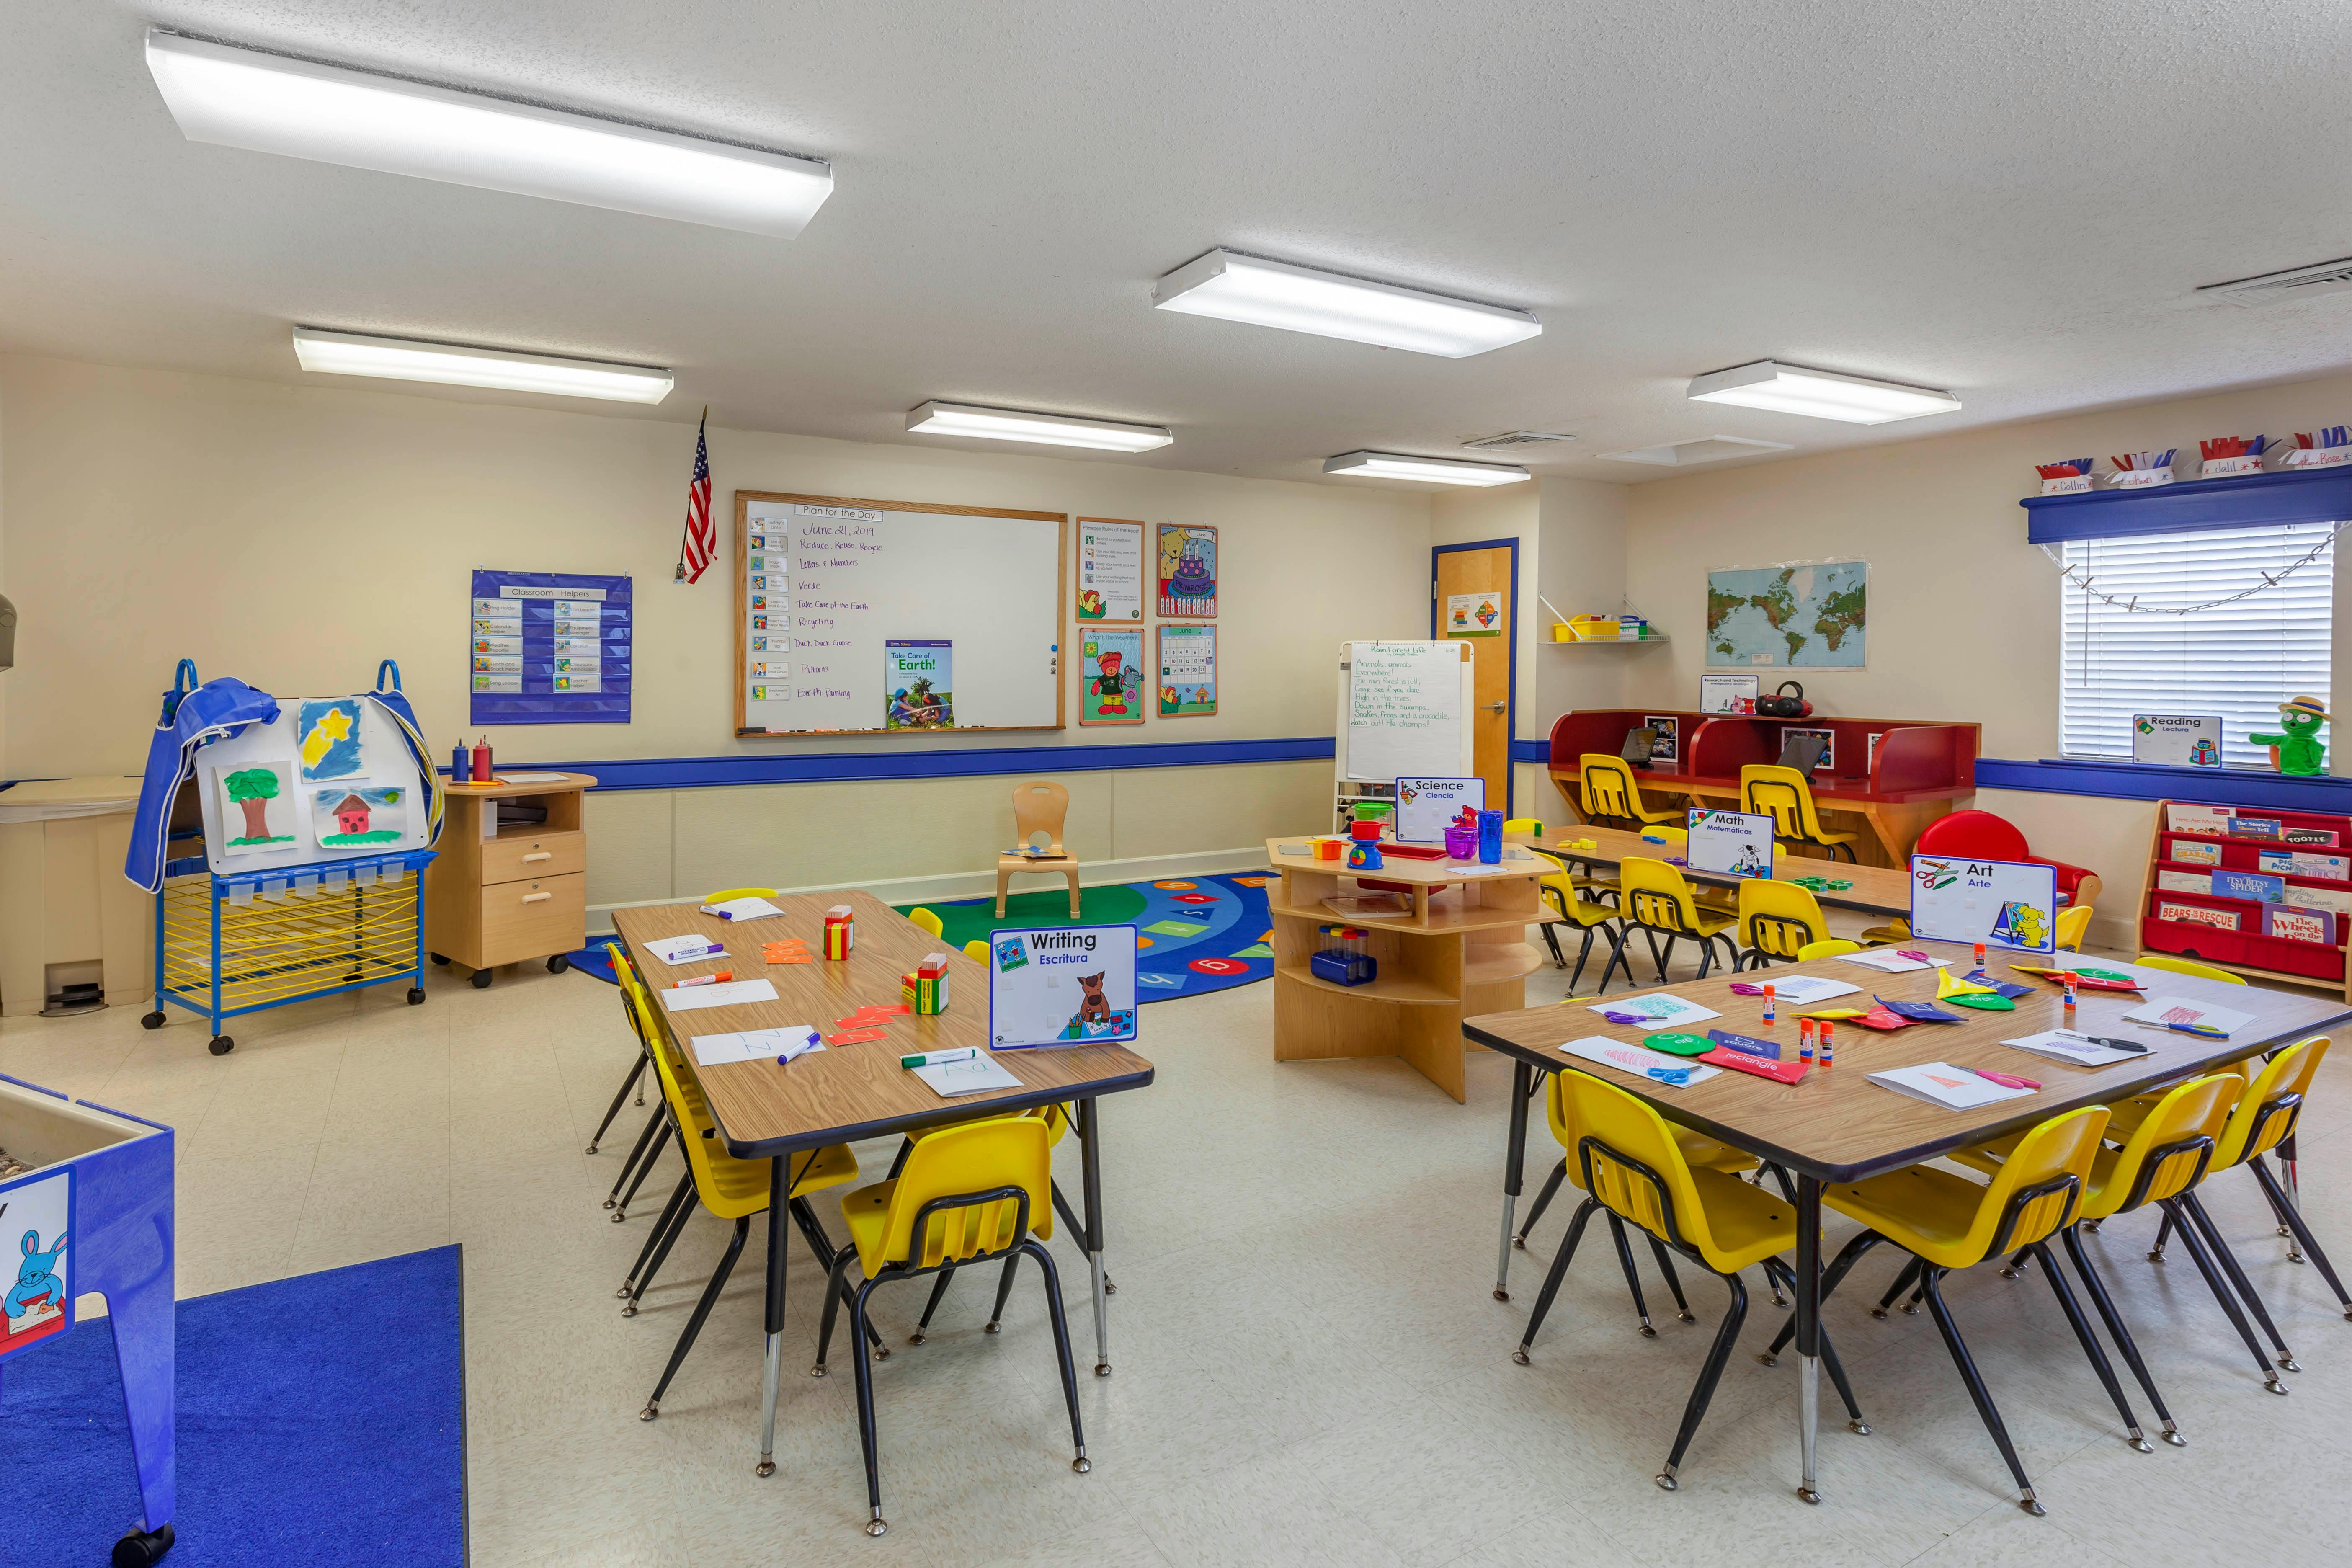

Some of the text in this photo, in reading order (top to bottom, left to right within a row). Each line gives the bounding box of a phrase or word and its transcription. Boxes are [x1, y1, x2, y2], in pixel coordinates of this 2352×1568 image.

[2321, 453, 2342, 464] Rose
[2215, 461, 2236, 473] Jalil
[2060, 480, 2086, 491] Collin
[804, 505, 823, 515] Plan
[858, 511, 875, 520] Day
[802, 523, 832, 536] June
[853, 526, 874, 536] 2019
[860, 542, 883, 554] Recycle
[830, 557, 858, 567] Numbers
[799, 580, 821, 590] Verde
[795, 600, 813, 609] Take
[851, 602, 869, 611] Earth
[799, 617, 834, 629] Recycling
[899, 659, 935, 670] Earth!
[1356, 668, 1394, 676] Everywhere!
[1354, 676, 1366, 684] The
[825, 688, 851, 700] Painting
[1354, 684, 1371, 693] Come
[1355, 694, 1370, 703] High
[1354, 701, 1374, 709] Down
[1399, 719, 1429, 729] chomps!
[2151, 717, 2201, 727] Reading
[1416, 780, 1464, 790] Science
[1715, 814, 1744, 825] Math
[1707, 825, 1752, 835] Matemáticas
[1966, 864, 1994, 877] Art
[1968, 879, 1991, 888] Arte
[2226, 877, 2269, 888] ITSY BITSY
[2231, 883, 2264, 893] SPIDER
[2294, 895, 2333, 906] Ballerina
[2162, 907, 2191, 919] BEARS
[2199, 909, 2233, 928] RESCUE
[2272, 919, 2325, 934] Wheels
[2293, 917, 2313, 926] The
[2308, 931, 2322, 940] the
[1031, 932, 1096, 951] Writing
[1039, 954, 1088, 965] Escritura
[1724, 1039, 1764, 1051] square
[1725, 1052, 1778, 1070] rectangle
